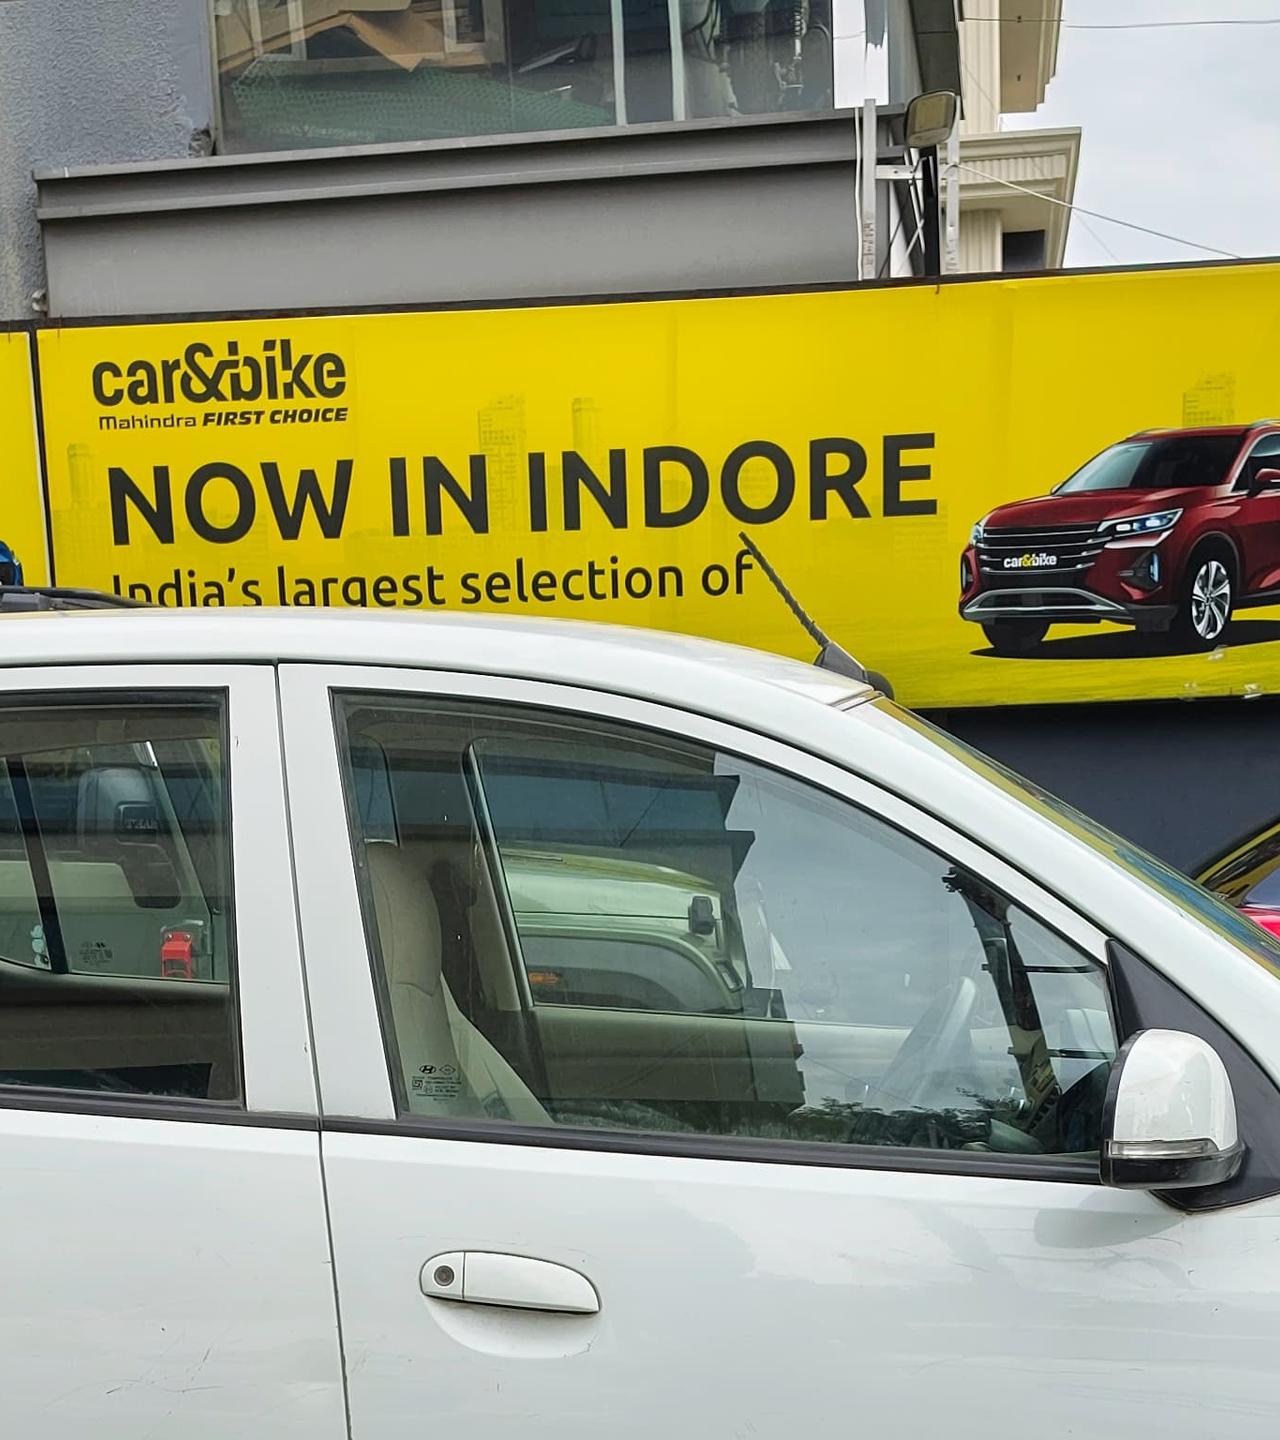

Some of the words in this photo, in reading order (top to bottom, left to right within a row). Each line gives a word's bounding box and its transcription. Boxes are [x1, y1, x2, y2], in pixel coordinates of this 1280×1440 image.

[92, 339, 346, 407] car&bike
[99, 413, 196, 431] Mahindra
[203, 410, 266, 427] FIRST
[269, 407, 349, 425] CHOICE
[108, 458, 354, 546] NOW
[389, 454, 489, 537] IN
[528, 432, 938, 532] INDORE
[276, 565, 447, 607] largest
[460, 556, 684, 605] selection
[701, 549, 754, 596] of
[1003, 552, 1058, 568] car&bike
